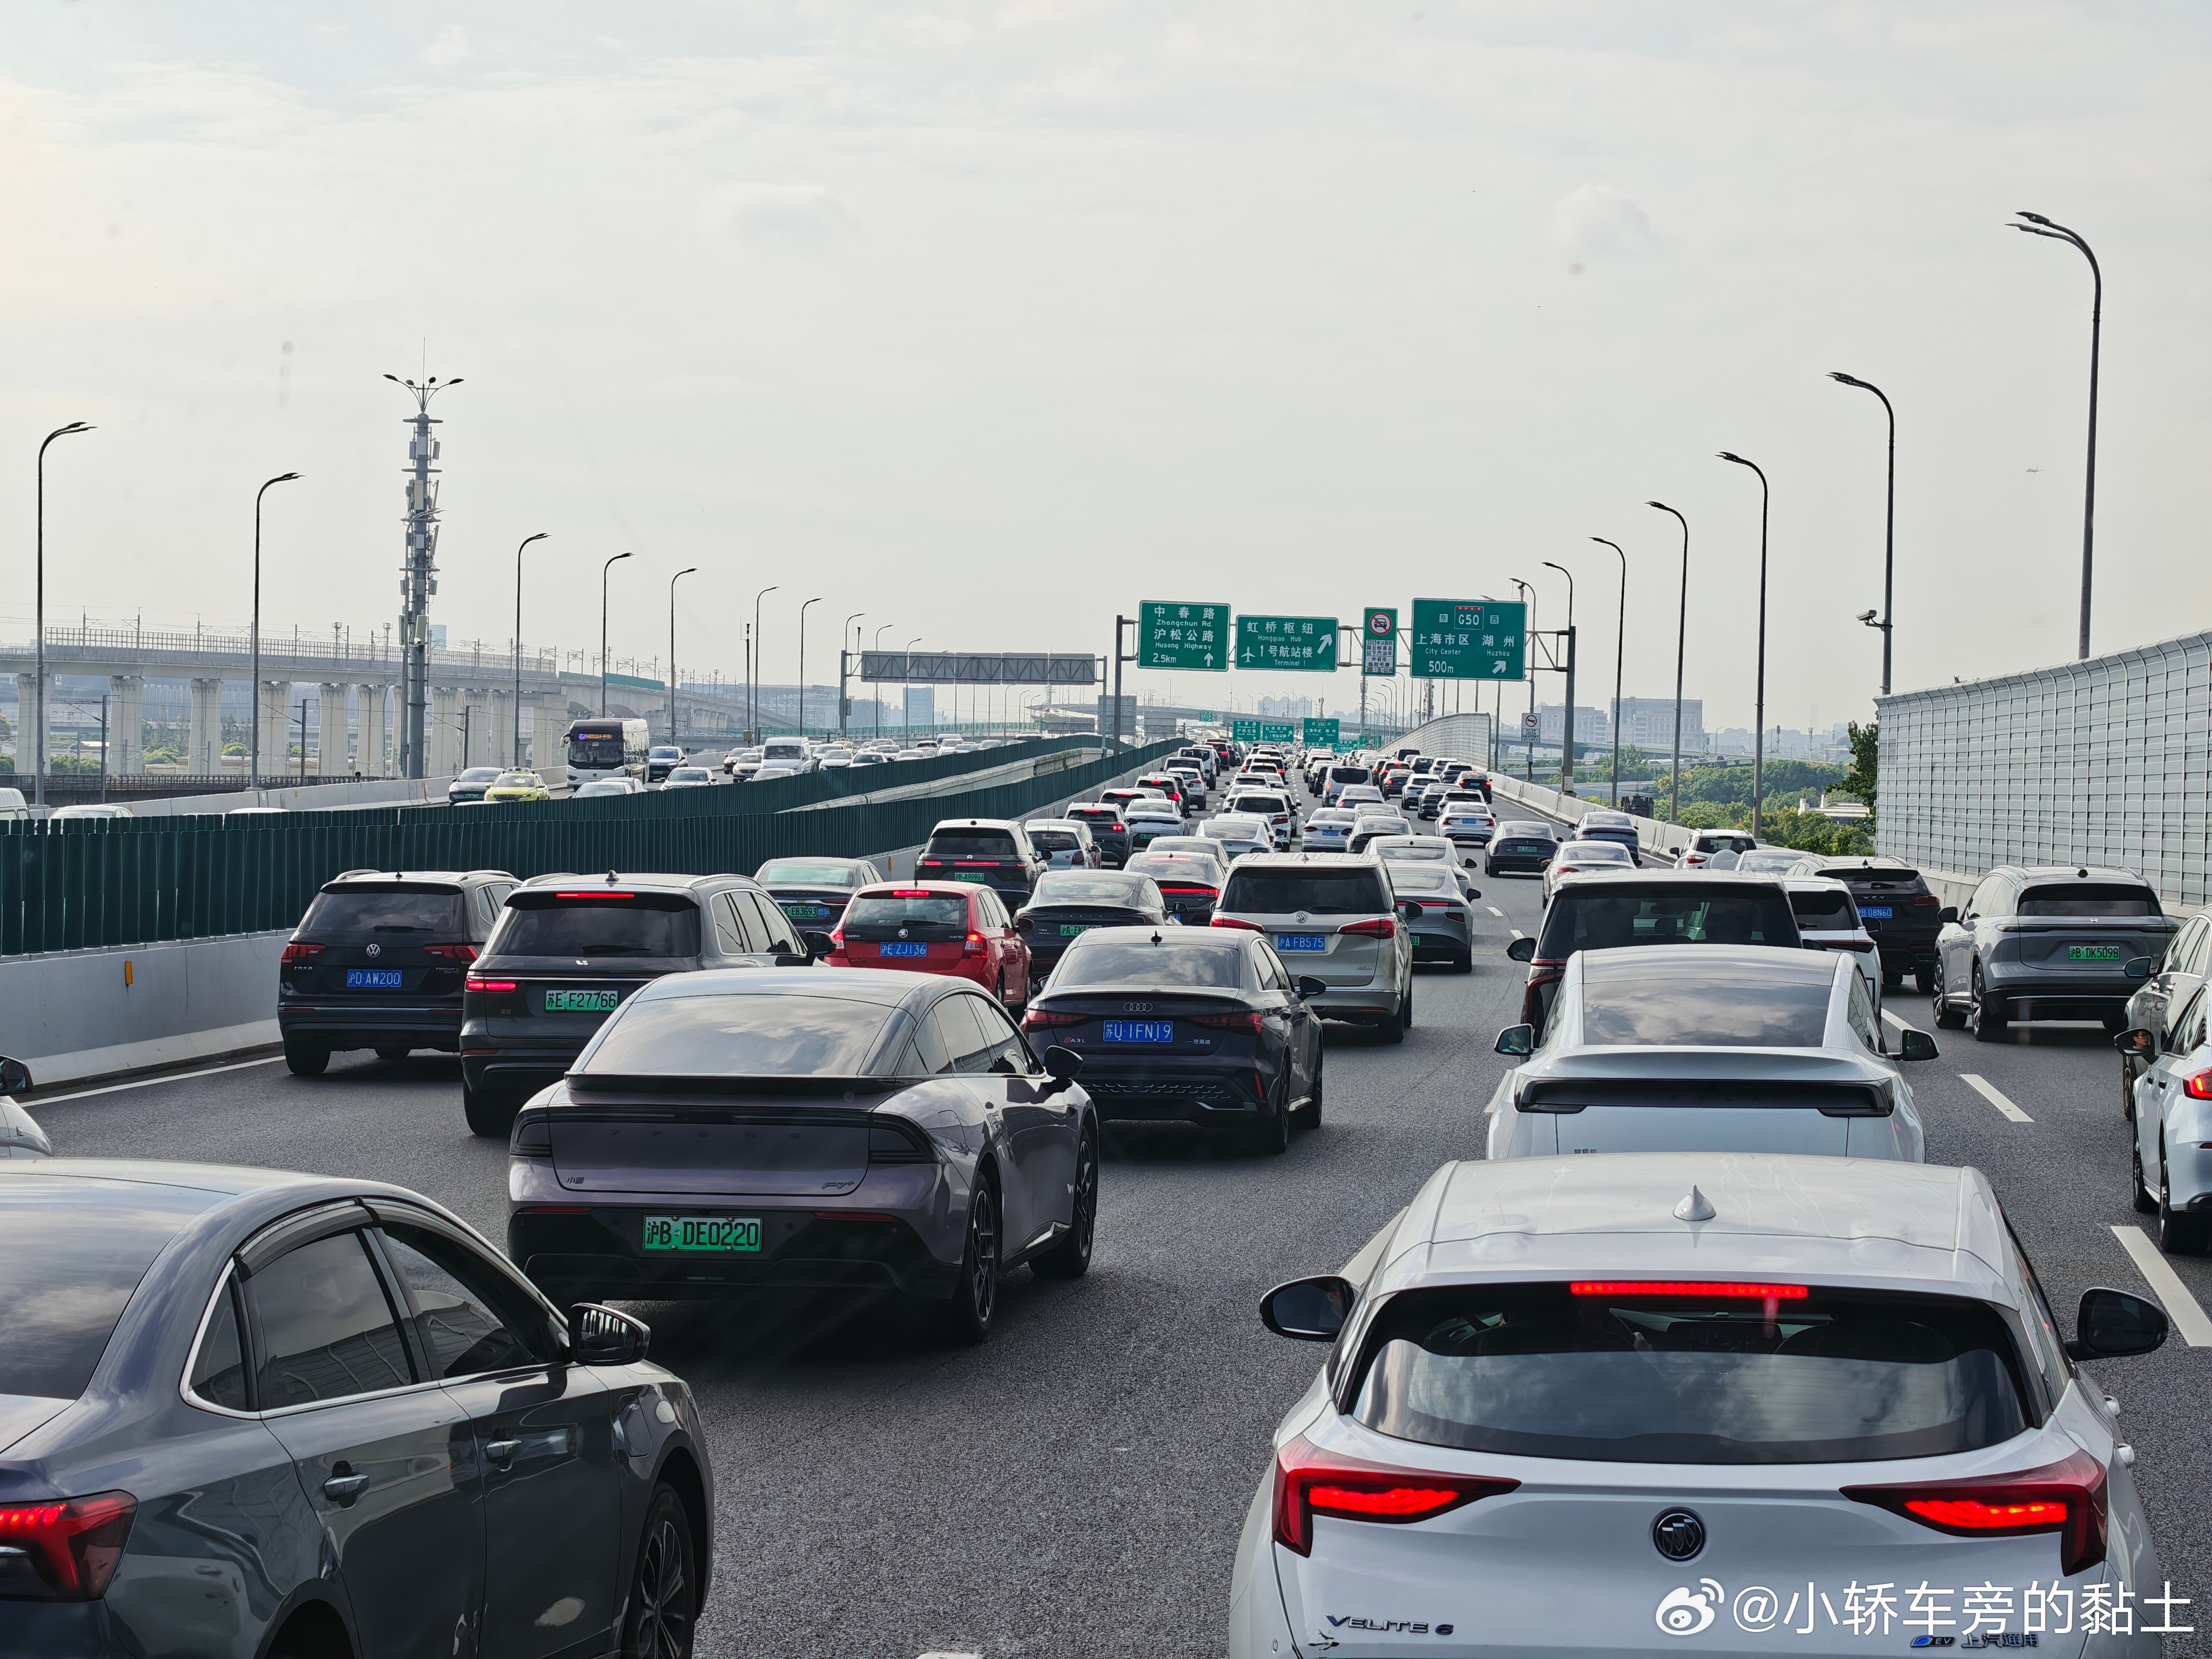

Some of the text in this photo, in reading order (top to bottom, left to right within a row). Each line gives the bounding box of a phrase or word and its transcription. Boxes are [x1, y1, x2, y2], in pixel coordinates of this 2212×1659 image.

[1154, 605, 1215, 619] 中春路
[1156, 619, 1198, 628] Zhongchun
[1459, 614, 1479, 625] G50
[1246, 621, 1313, 634] 虹桥枢纽
[1154, 628, 1215, 642] 沪松公路
[1258, 635, 1285, 643] Hongqiao
[1416, 633, 1515, 647] 上海市区 湖州
[1184, 643, 1212, 651] Highway
[1260, 644, 1313, 658] 1号航站楼
[1425, 648, 1438, 656] City
[1152, 652, 1177, 663] 2.5km
[1428, 660, 1454, 673] 500m
[782, 907, 817, 915] A·E83693
[1325, 1613, 1454, 1635] VELITE 6
[1961, 1633, 2040, 1648] 上汽通用
